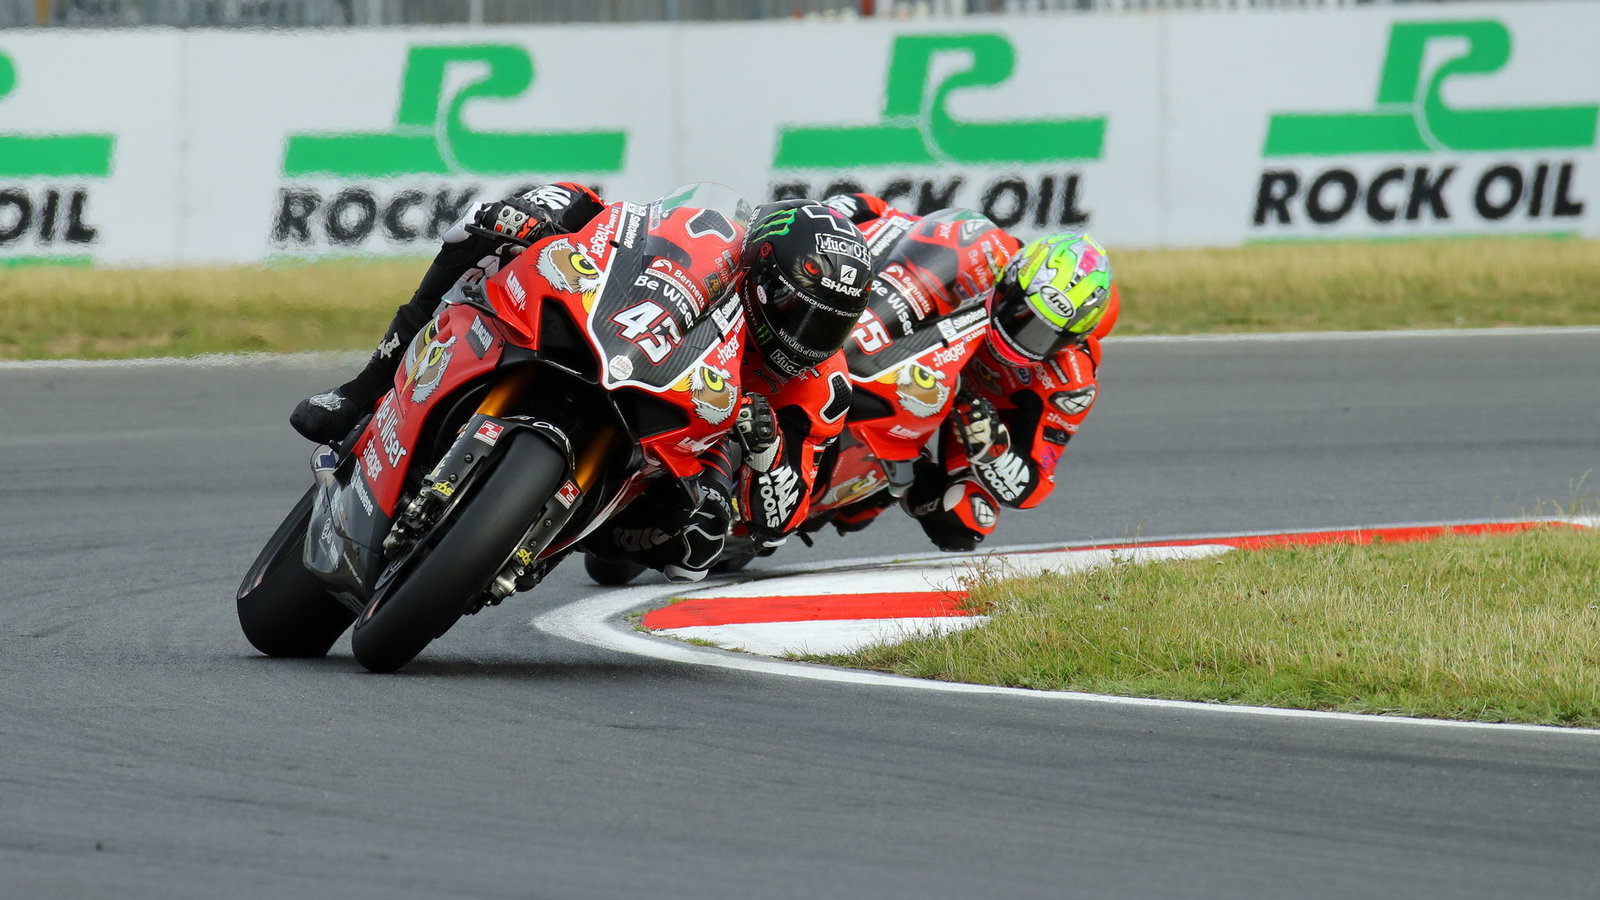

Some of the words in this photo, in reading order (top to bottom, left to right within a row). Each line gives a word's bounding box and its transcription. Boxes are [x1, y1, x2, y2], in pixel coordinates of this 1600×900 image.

[0, 188, 98, 243] OIL
[272, 186, 480, 243] ROCK
[985, 172, 1088, 228] OIL
[1252, 168, 1457, 225] ROCK
[1474, 162, 1583, 220] OIL
[634, 275, 660, 290] Be
[663, 283, 695, 329] Wiser
[674, 269, 705, 308] Bennetts
[820, 276, 863, 298] SHARK
[871, 279, 889, 297] Be
[887, 292, 915, 337] Wiser
[902, 275, 931, 313] Bennetts
[1042, 290, 1074, 315] Arai
[608, 299, 685, 366] 45
[380, 409, 408, 468] Wiser
[432, 481, 455, 498] sbs
[758, 473, 780, 529] TOOLS
[769, 465, 800, 524] MAC
[993, 451, 1030, 498] MAC
[517, 548, 534, 566] sbs
